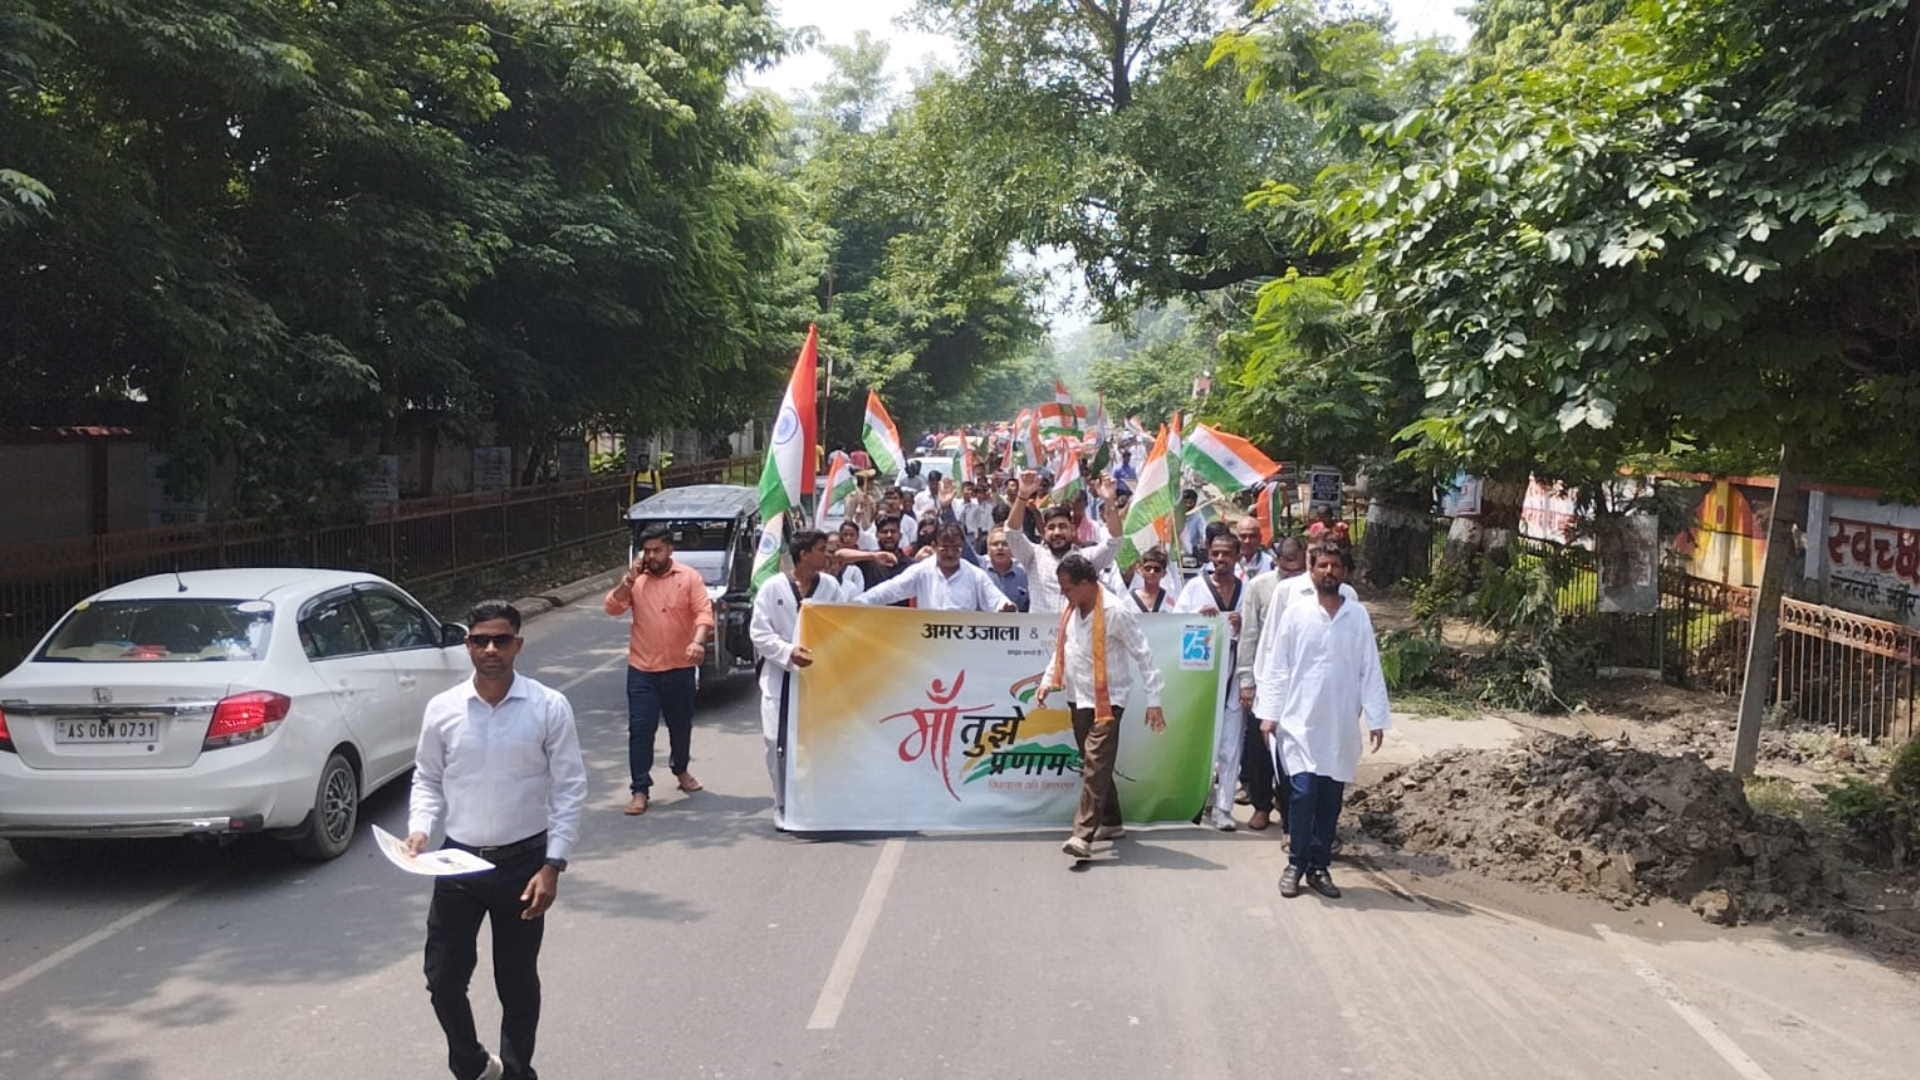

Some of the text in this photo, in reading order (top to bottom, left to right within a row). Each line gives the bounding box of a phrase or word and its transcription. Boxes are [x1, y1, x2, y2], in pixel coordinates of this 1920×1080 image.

[921, 623, 963, 639] अमर
[966, 625, 1019, 641] उजाला
[68, 724, 84, 738] AS
[120, 722, 154, 738] 0731
[961, 705, 1025, 758] तुझे
[989, 751, 1072, 776] प्रणाम
